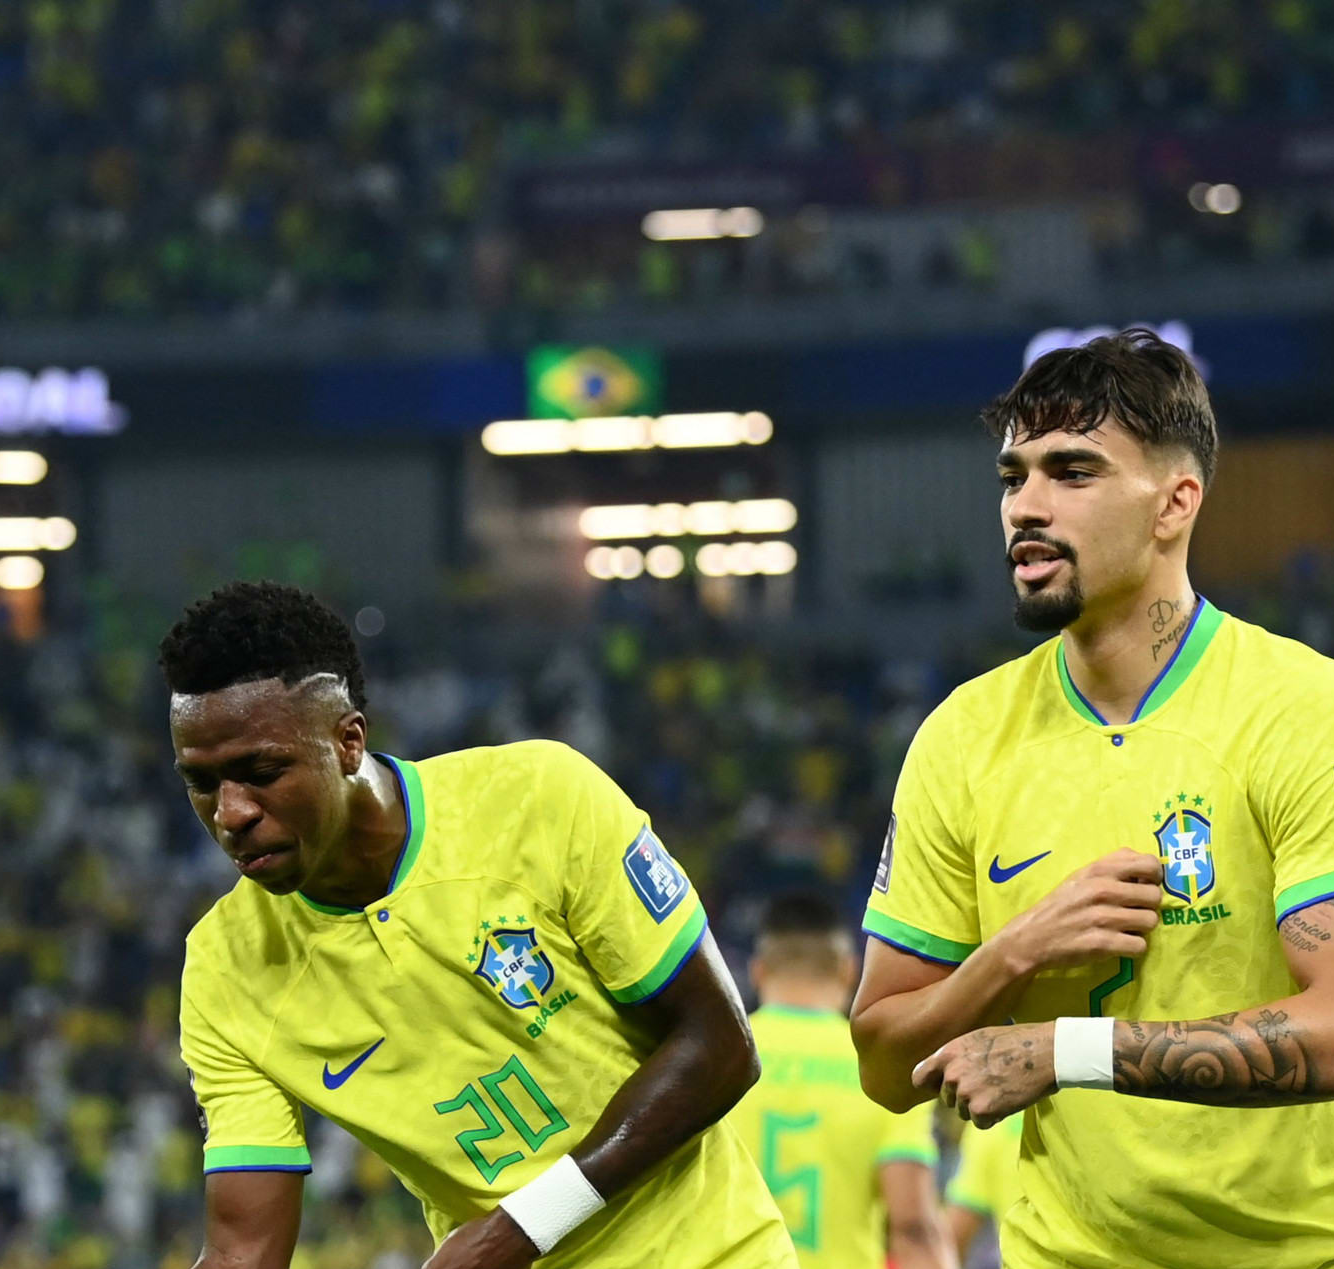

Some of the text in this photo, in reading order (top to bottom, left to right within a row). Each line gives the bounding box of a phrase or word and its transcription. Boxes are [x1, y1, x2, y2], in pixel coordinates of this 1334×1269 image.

[1174, 848, 1199, 860] CBF
[1161, 904, 1231, 925] BRASIL
[503, 957, 526, 979] CBF
[526, 989, 578, 1039] BRASIL
[433, 1054, 570, 1185] 20
[763, 1108, 820, 1252] 5
